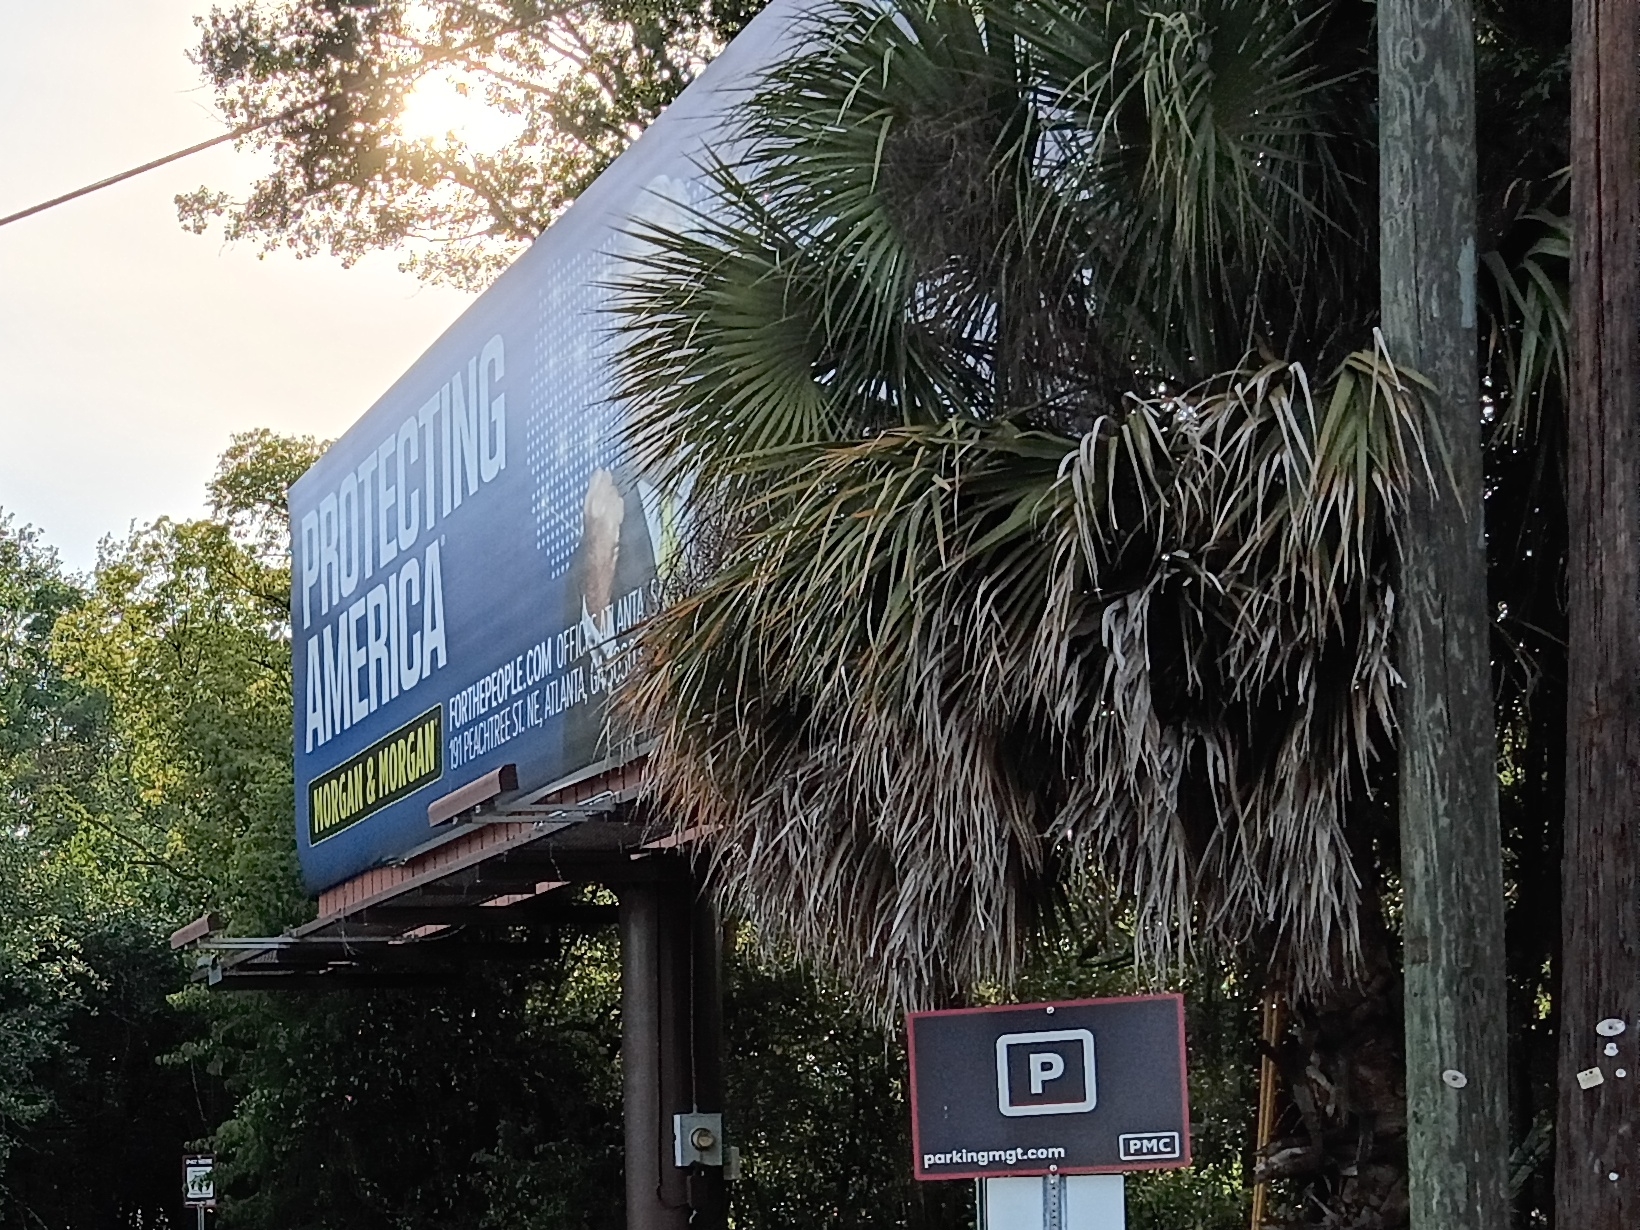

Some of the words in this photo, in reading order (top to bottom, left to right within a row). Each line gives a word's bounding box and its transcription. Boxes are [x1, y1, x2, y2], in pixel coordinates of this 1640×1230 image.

[302, 334, 506, 629] PROTECTING
[305, 538, 447, 753] AMERICA
[449, 636, 552, 732] FORTHEPEOPLE.COM
[449, 734, 463, 770] 191
[463, 706, 511, 763] PEACHTREE
[512, 699, 525, 737] ST.
[527, 690, 543, 728] NE,
[544, 665, 588, 719] ATLANTA,
[313, 762, 364, 834] MORGAN
[366, 756, 376, 805] &
[378, 719, 435, 799] MORGAN
[1029, 1052, 1065, 1095] P
[923, 1145, 1065, 1168] parkingmgt.com
[1129, 1138, 1172, 1154] PMC
